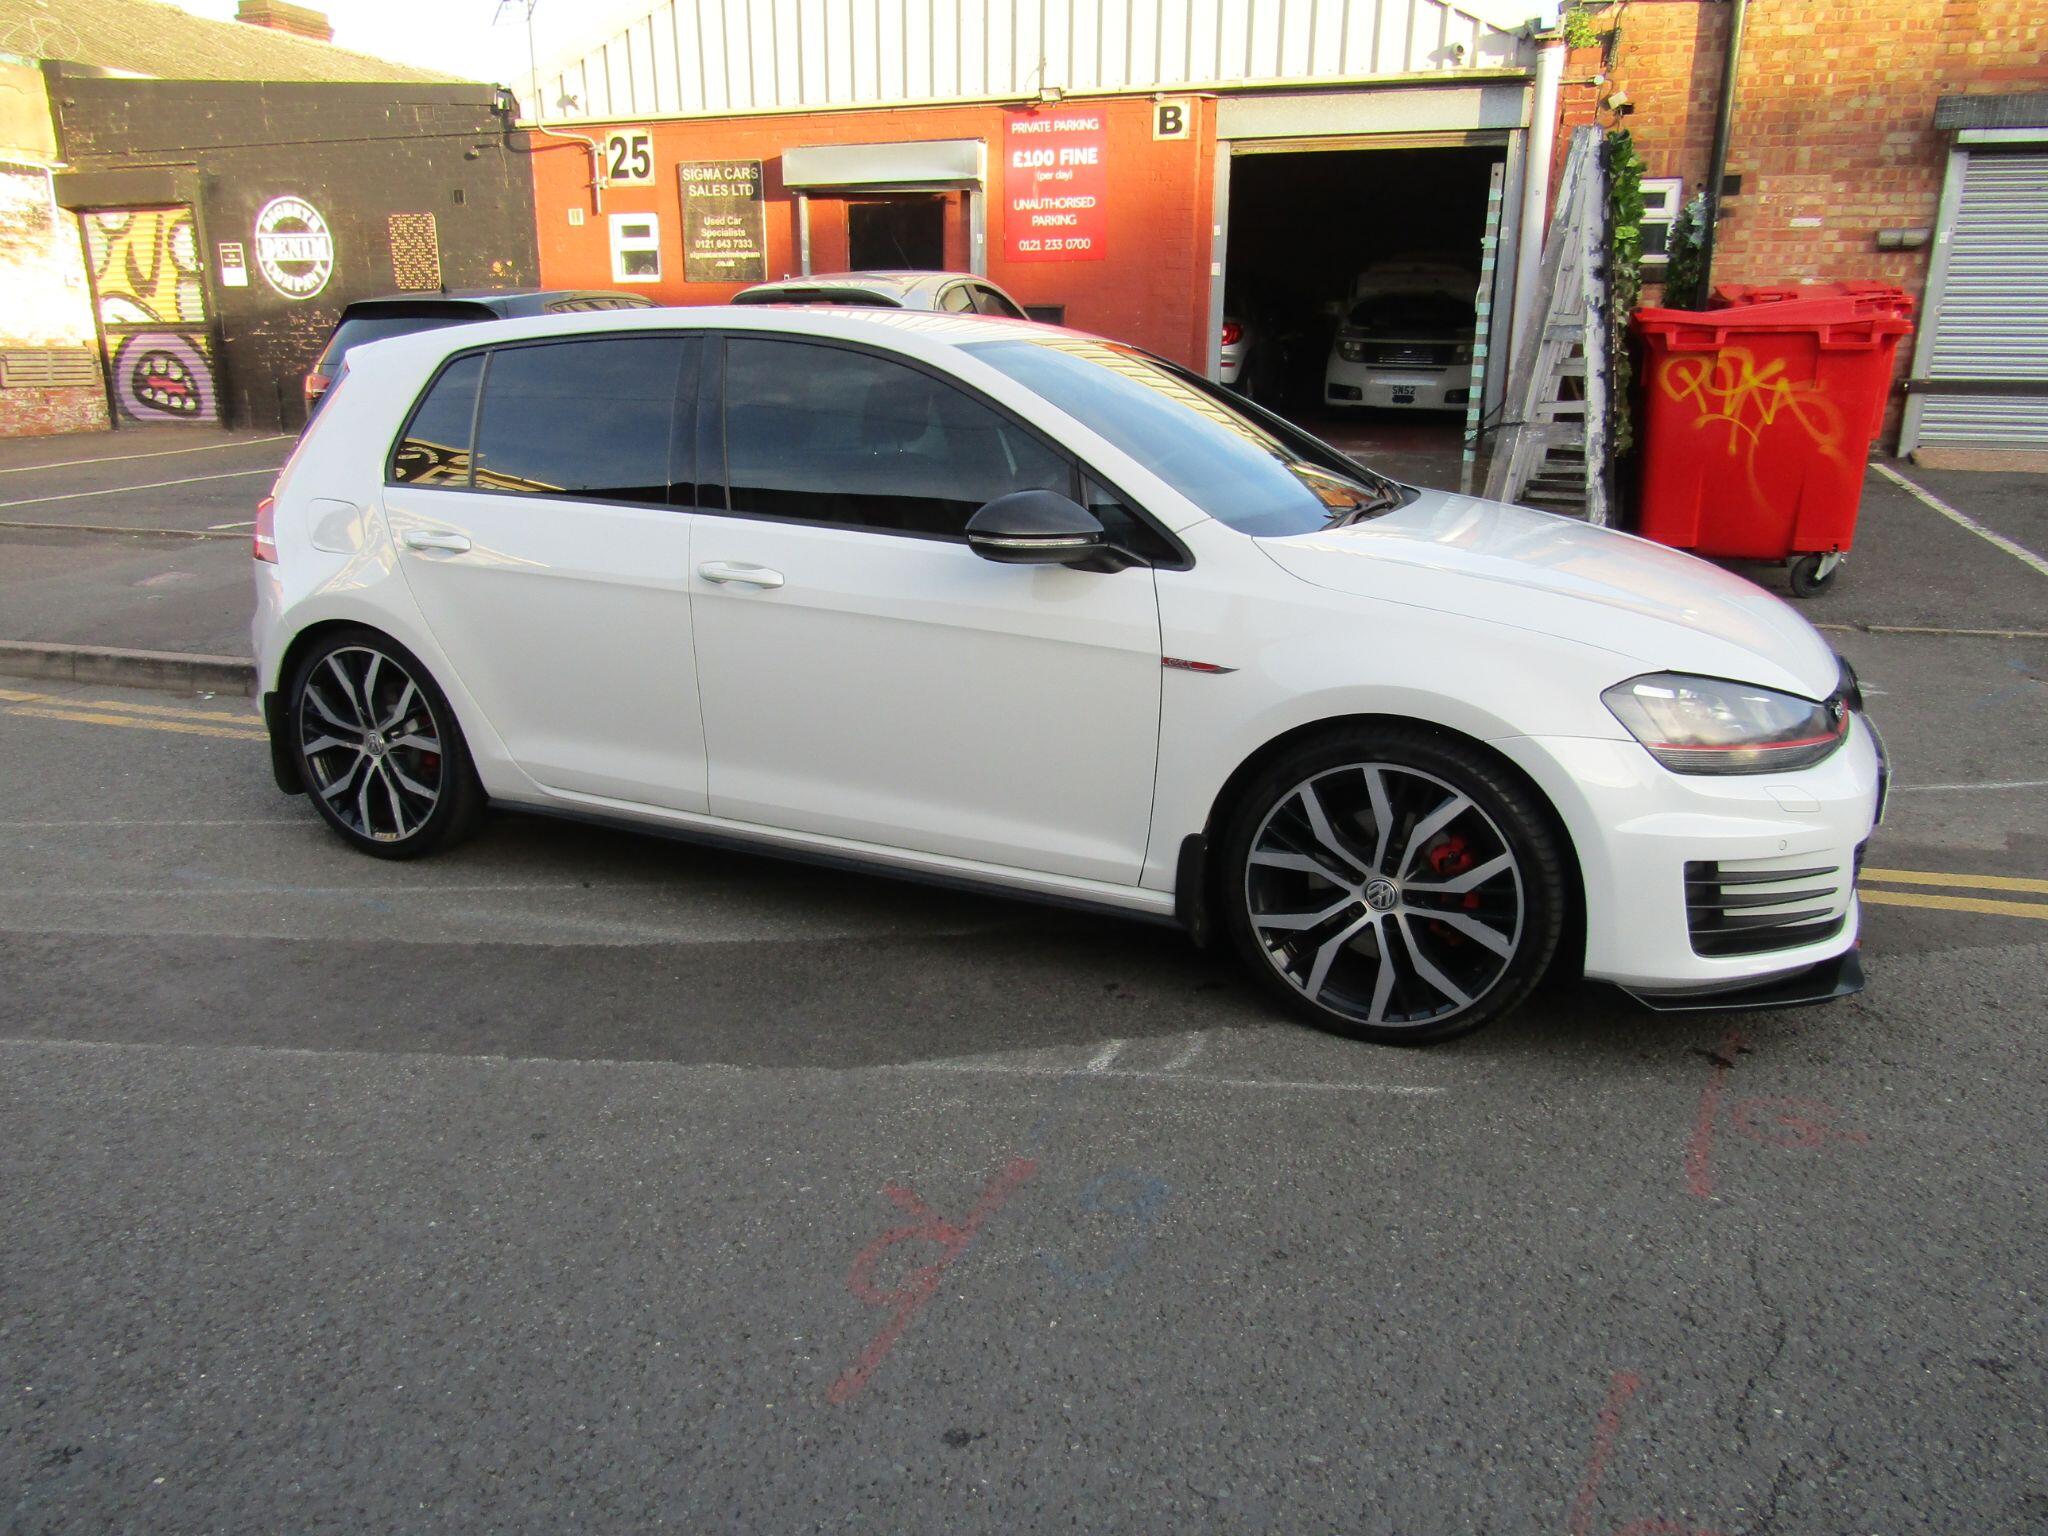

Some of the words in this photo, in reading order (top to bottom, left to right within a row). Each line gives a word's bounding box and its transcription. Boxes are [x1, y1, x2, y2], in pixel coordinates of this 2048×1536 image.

[1011, 119, 1052, 134] PRIVATE
[1053, 118, 1099, 132] PARKING
[1159, 106, 1183, 135] B
[609, 136, 651, 179] 25
[1012, 149, 1055, 168] £100
[1059, 147, 1099, 166] FINE
[682, 168, 722, 181] SIGMA
[724, 166, 759, 180] CARS
[1036, 170, 1054, 182] (per
[1055, 169, 1073, 181] day)
[688, 184, 729, 197] SALES
[731, 184, 754, 196] LTD
[1013, 196, 1096, 211] UNAUTHORISED
[704, 216, 726, 226] Used
[727, 216, 743, 226] Car
[1031, 213, 1077, 227] PARKING
[701, 228, 746, 239] Specialists
[259, 236, 329, 260] DENIM
[695, 239, 715, 249] 0121
[733, 239, 753, 249] 7333
[1018, 239, 1042, 252] 0121
[1044, 238, 1063, 250] 233
[1065, 238, 1091, 250] 0700
